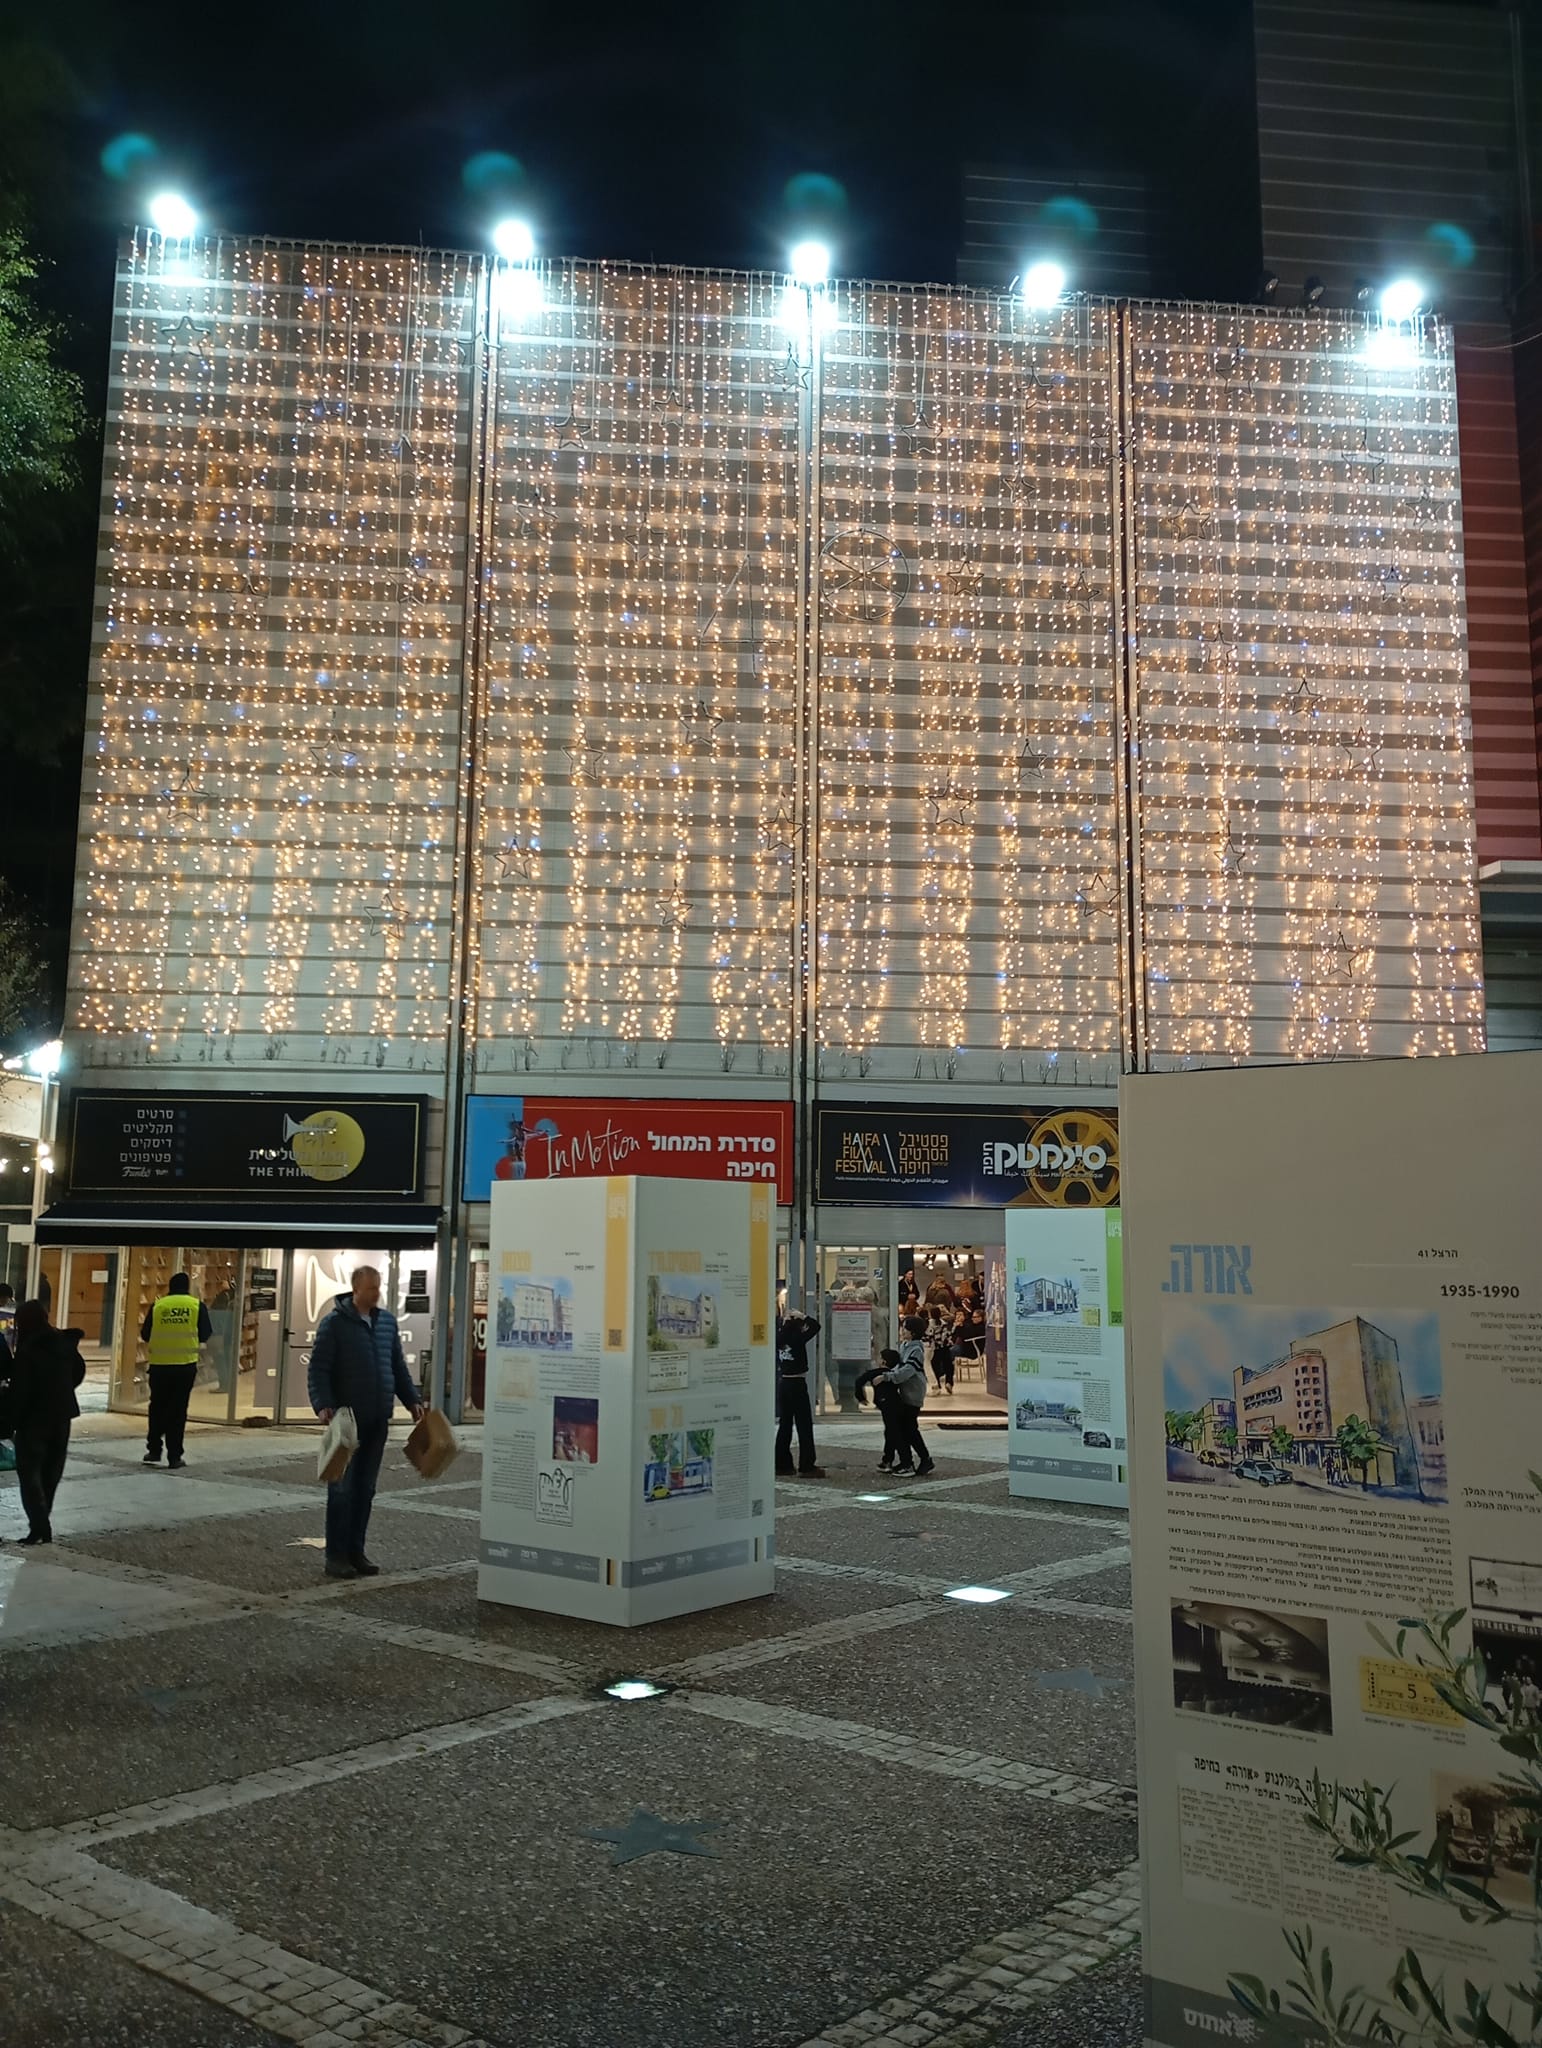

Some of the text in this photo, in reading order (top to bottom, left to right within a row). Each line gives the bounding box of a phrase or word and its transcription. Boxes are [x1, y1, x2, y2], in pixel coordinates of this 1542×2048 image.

[137, 1109, 174, 1119] סרטים
[123, 1122, 173, 1134] תקליטים
[130, 1138, 172, 1149] דיסקים
[647, 1131, 776, 1154] סדרת המחול
[843, 1132, 880, 1146] HAIFA
[898, 1131, 948, 1147] פסטיבל
[120, 1152, 171, 1163] פטיפונים
[842, 1146, 873, 1160] FILM
[899, 1147, 948, 1161] הסרטים
[983, 1142, 993, 1175] חיפה
[993, 1142, 1107, 1175] סינמטק
[249, 1167, 274, 1176] THE
[726, 1161, 776, 1178] חיפה
[835, 1159, 887, 1174] FESTIVAL
[899, 1161, 930, 1175] חיפה
[1418, 1248, 1458, 1259] הרצל 41
[1161, 1245, 1252, 1295] אורה.
[1440, 1284, 1520, 1299] 1935-1990
[1488, 1490, 1503, 1498] היה
[1408, 1684, 1417, 1699] 5
[1194, 1757, 1220, 1773] בחיפה
[1225, 1782, 1280, 1800] באלפי לירות
